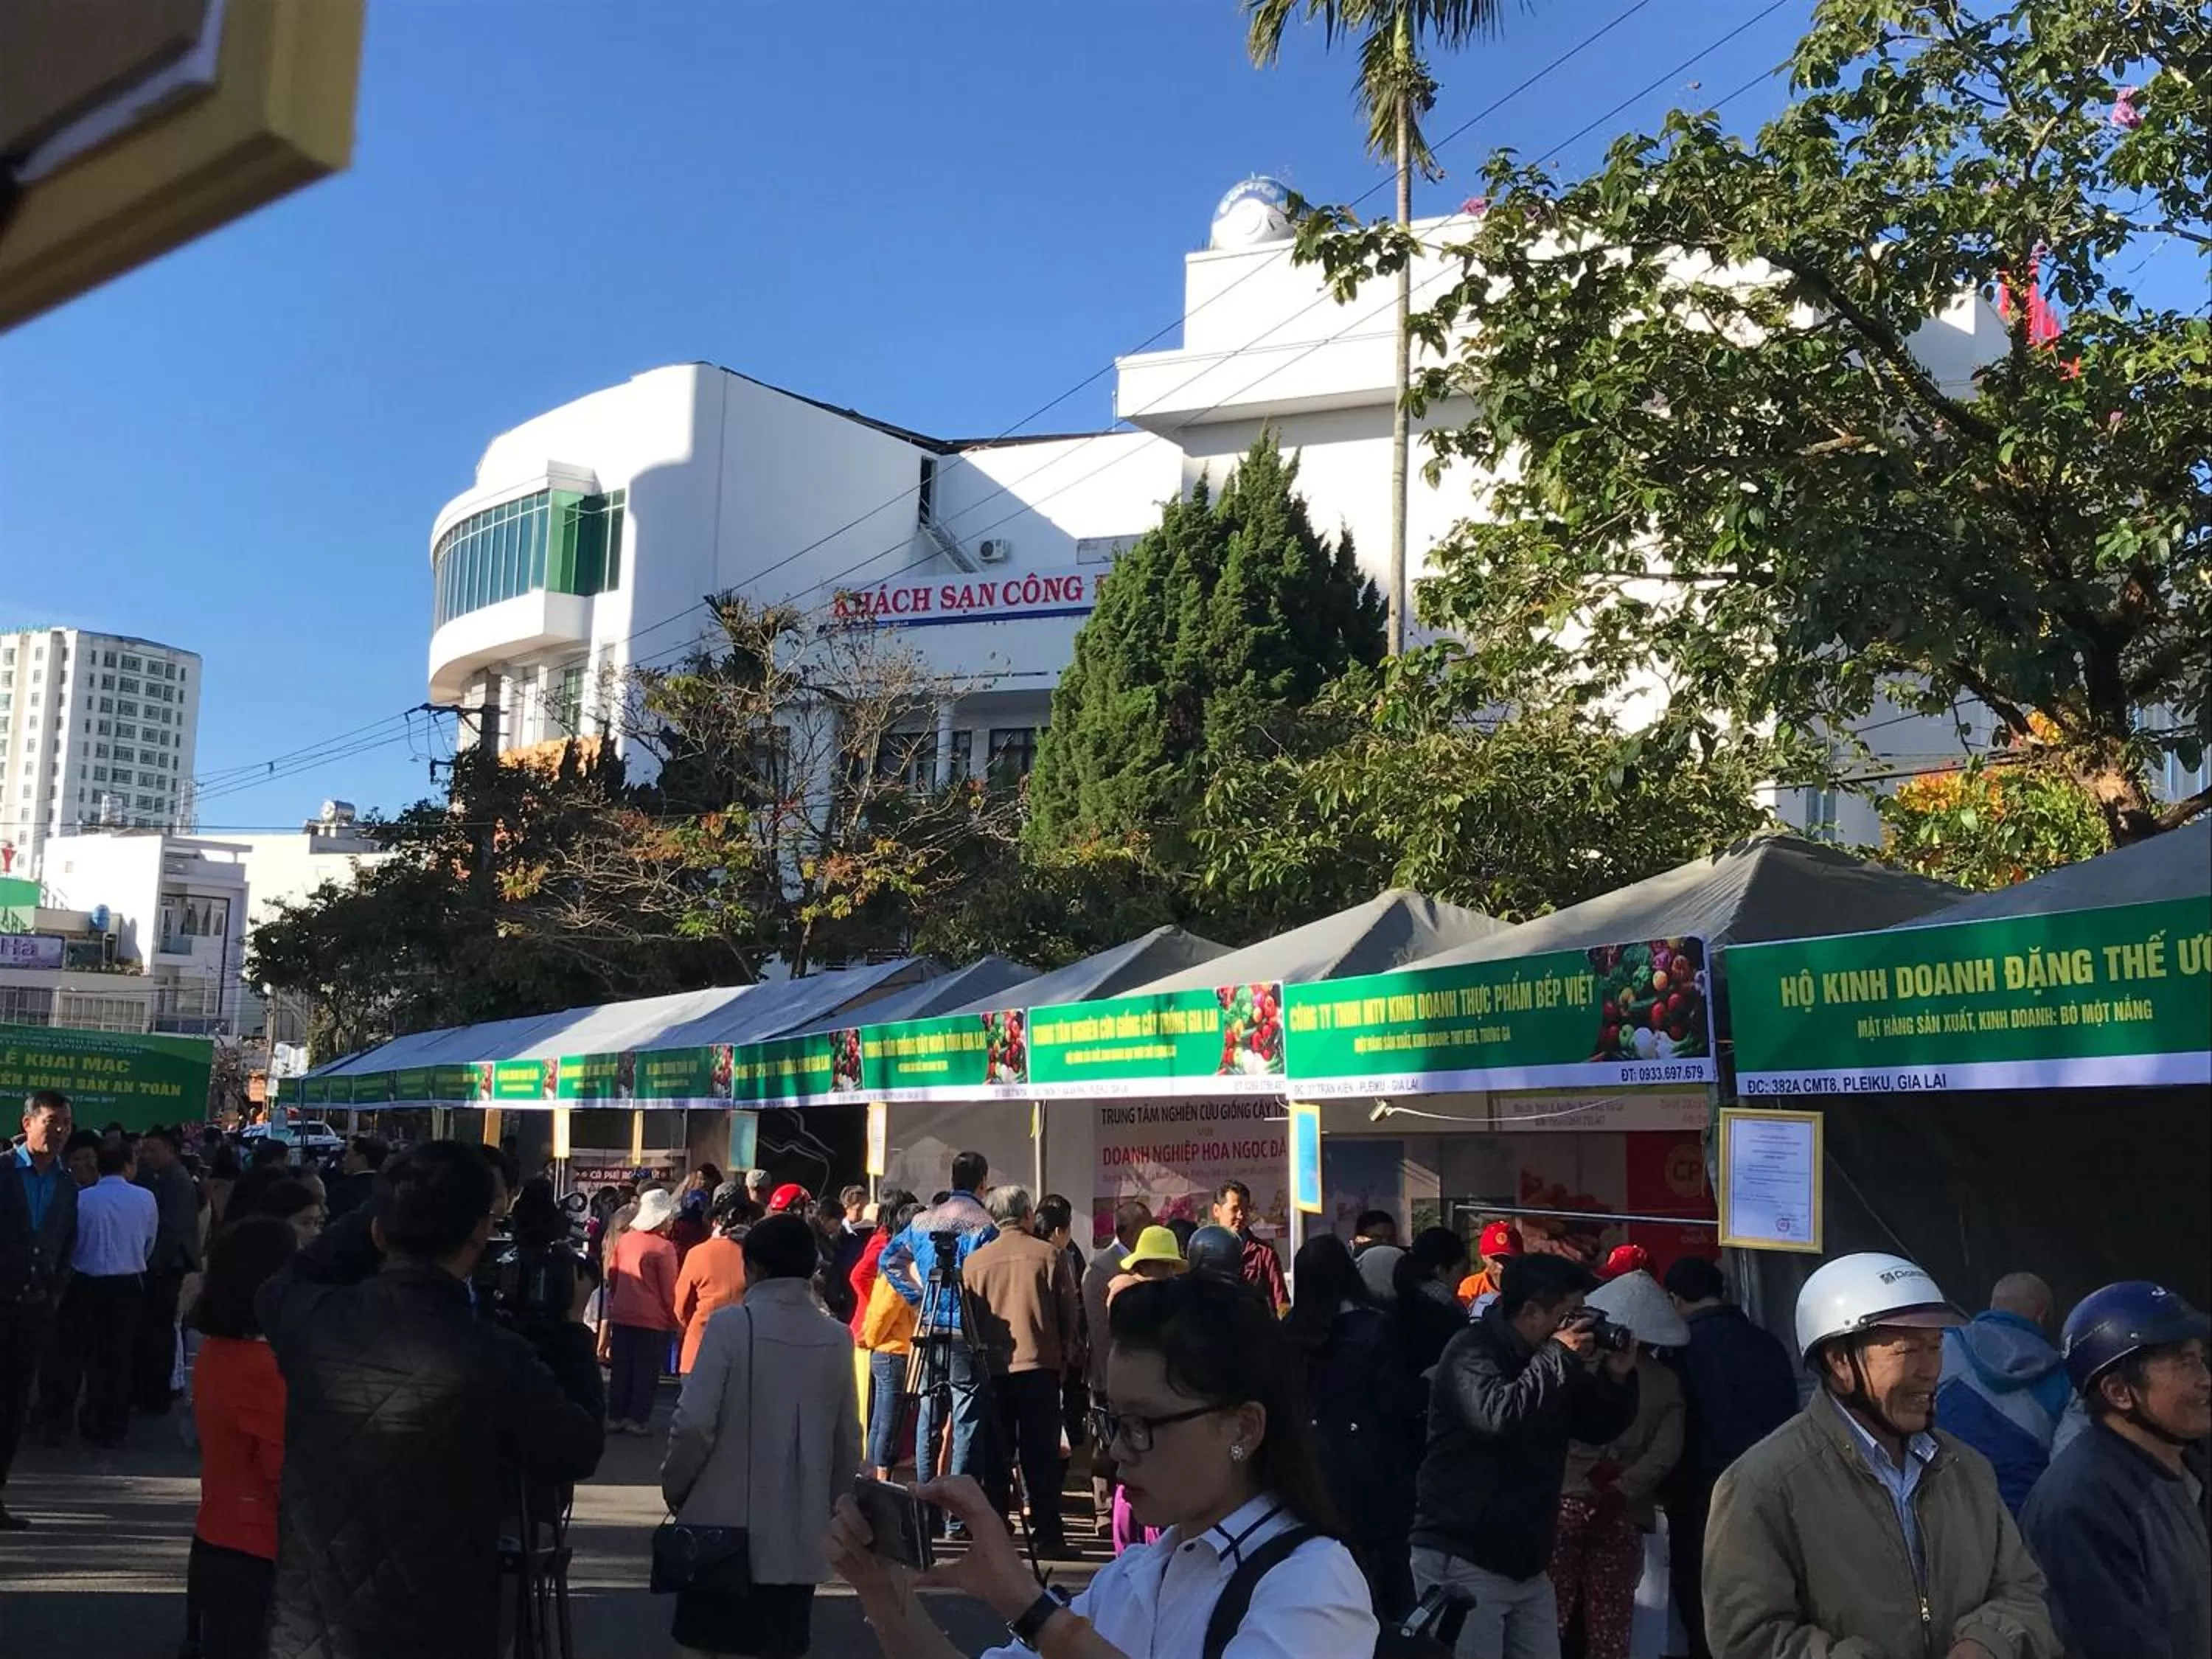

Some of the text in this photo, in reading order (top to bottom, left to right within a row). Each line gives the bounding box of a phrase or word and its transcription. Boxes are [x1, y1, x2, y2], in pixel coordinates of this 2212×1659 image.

[940, 581, 998, 613] SẠN
[1003, 572, 1083, 606] CÔNG
[1781, 969, 1815, 1013] HỘ
[1822, 968, 1888, 1004] KINH
[1895, 958, 1996, 999] DOANH
[2003, 946, 2094, 995] ĐẶNG
[2103, 929, 2167, 981] THẾ
[1318, 1003, 1332, 1029] TY
[1388, 994, 1416, 1023] KINH
[1418, 990, 1458, 1020] DOANH
[1460, 983, 1491, 1020] THỰC
[1494, 970, 1532, 1016] PHẨM
[1536, 970, 1561, 1009] BẾP
[1565, 969, 1594, 1012] VIỆT
[1857, 1017, 1882, 1042] MẶT
[1884, 1014, 1914, 1036] HÀNG
[1916, 1009, 1941, 1034] SẢN
[1944, 1005, 1977, 1033] XUẤT,
[1979, 1009, 2008, 1030] KINH
[2011, 1007, 2057, 1029] DOANH:
[2081, 998, 2110, 1027] MỘT
[24, 1052, 77, 1069] KHAI
[82, 1055, 131, 1074] MẠC
[1621, 1068, 1636, 1082] ĐT:
[112, 1082, 134, 1093] AN
[1747, 1079, 1769, 1094] ĐC:
[1772, 1079, 1801, 1093] 382A
[1844, 1075, 1894, 1092] PLEIKU,
[1897, 1074, 1921, 1090] GIA
[1924, 1073, 1947, 1089] LAI
[1102, 1107, 1135, 1125] TRUNG
[1137, 1104, 1160, 1123] TÂM
[1161, 1102, 1198, 1121] NGHIÊN
[1220, 1096, 1251, 1120] GIỐNG
[1253, 1099, 1272, 1119] CÂY
[1102, 1147, 1150, 1165] DOANH
[1152, 1140, 1200, 1166] NGHIỆP
[1203, 1145, 1228, 1161] HOA
[1233, 1141, 1267, 1162] NGỌC
[1673, 1160, 1703, 1180] CP
